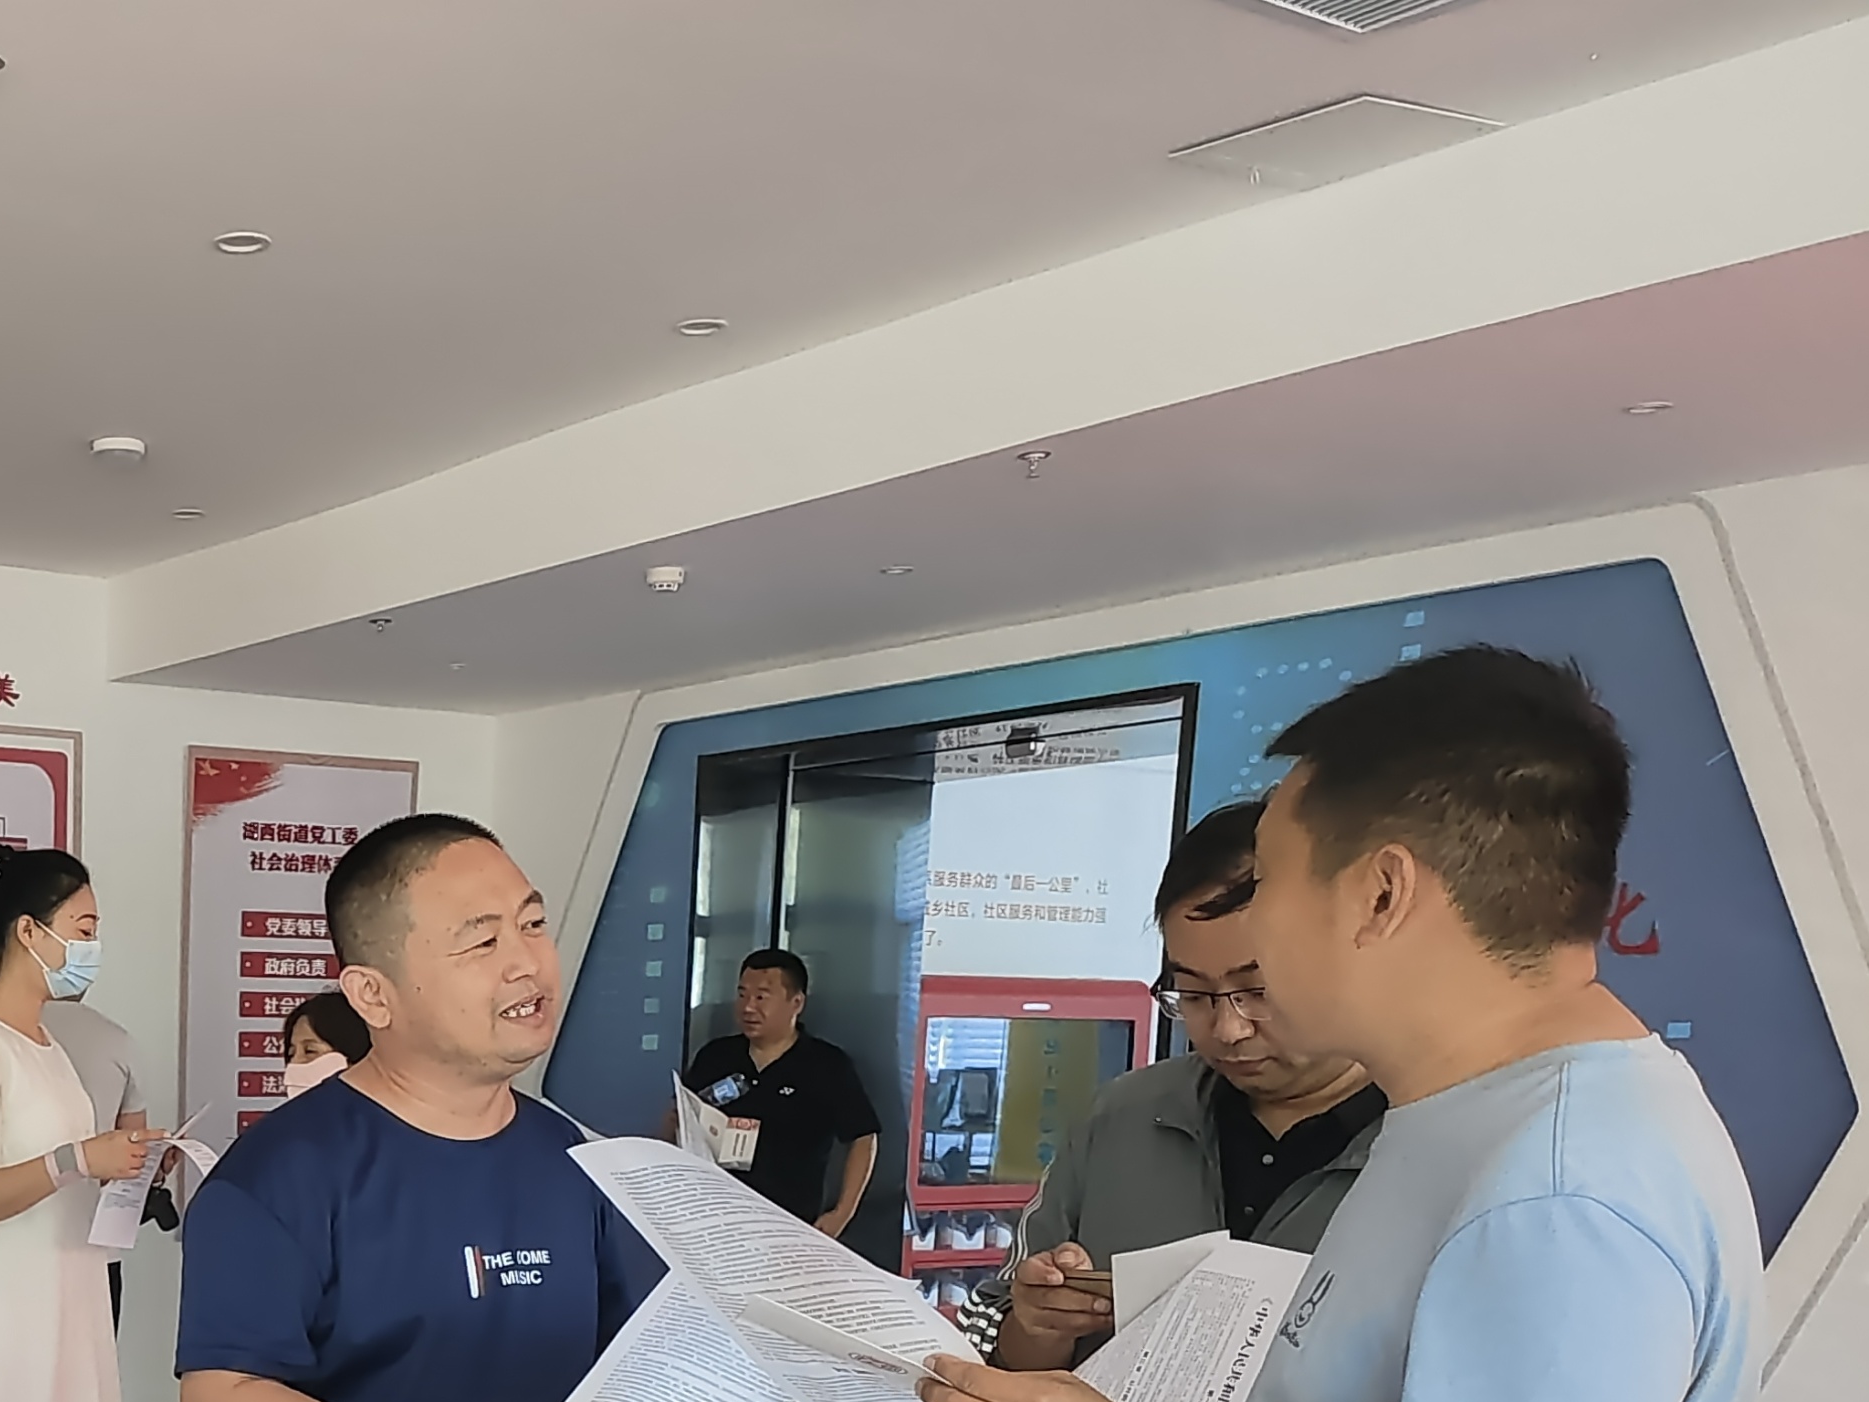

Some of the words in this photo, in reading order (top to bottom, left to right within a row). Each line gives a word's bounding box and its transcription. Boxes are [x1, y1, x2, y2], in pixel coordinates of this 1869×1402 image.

[250, 851, 342, 874] 社会治理体
[266, 918, 328, 937] 党委领导
[264, 958, 327, 976] 政府负责
[482, 1252, 515, 1270] THE
